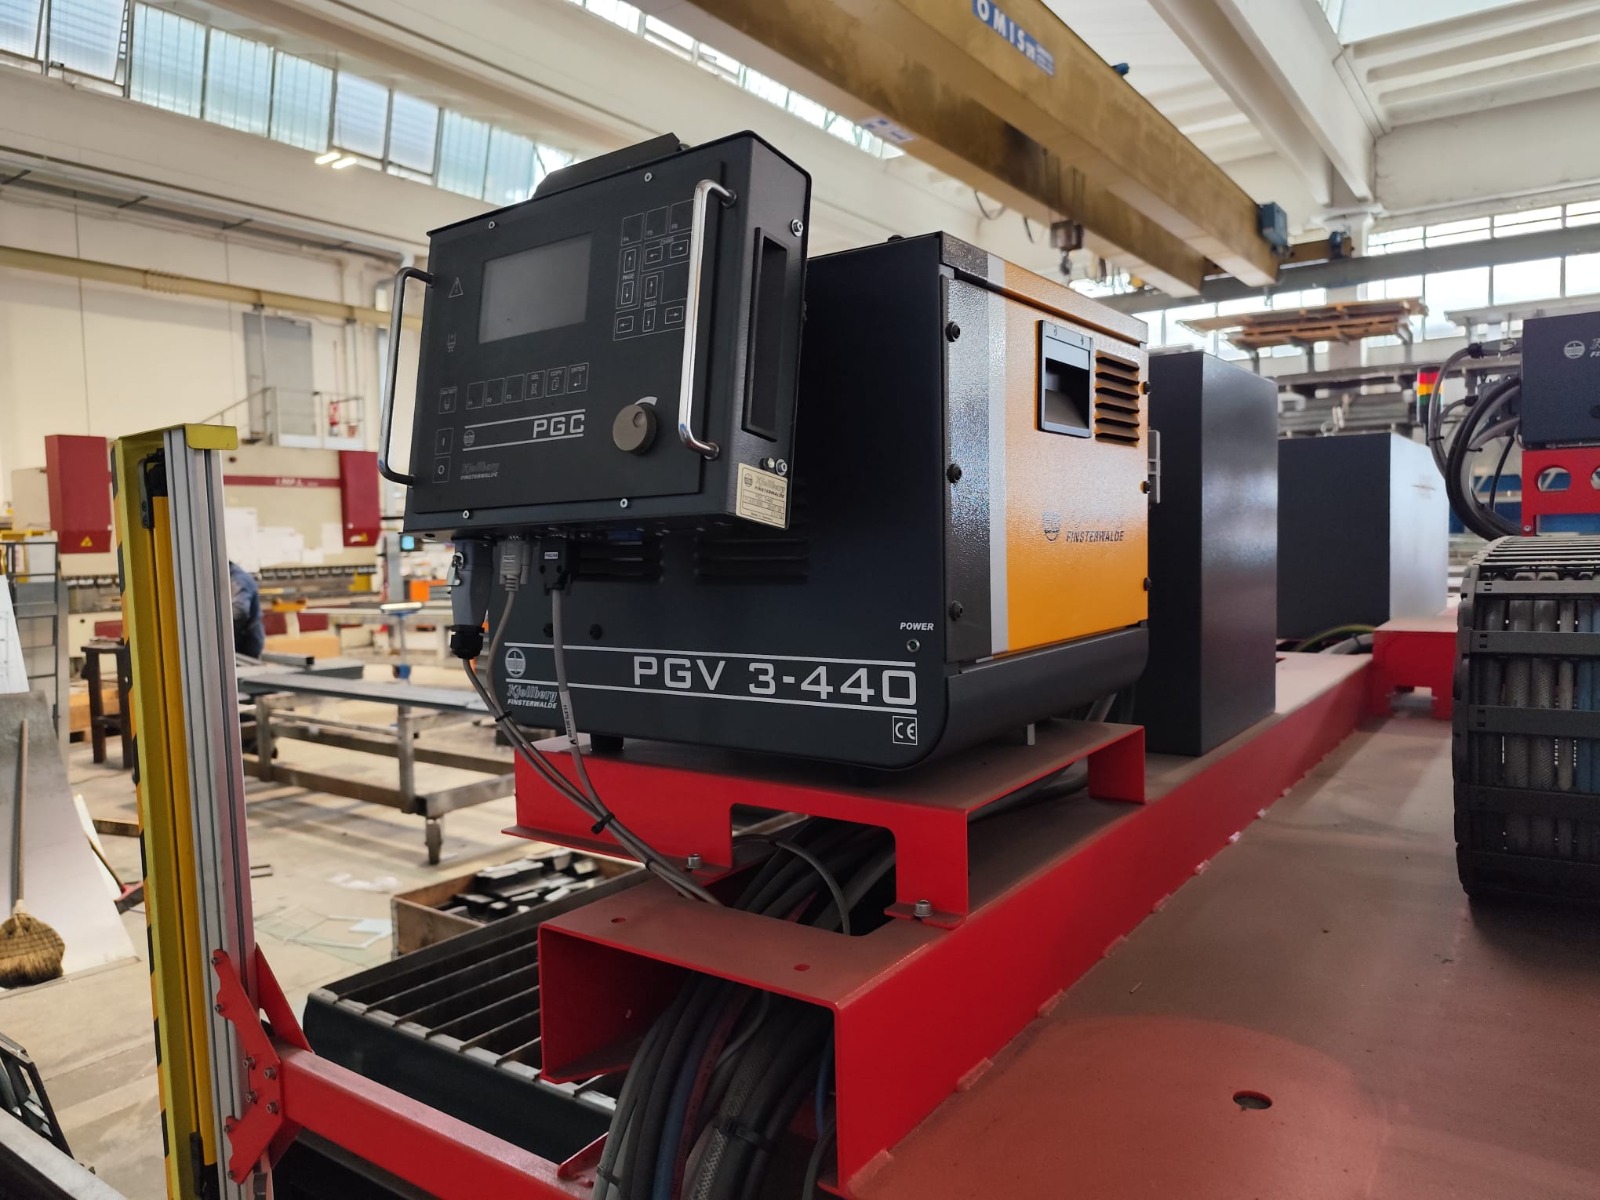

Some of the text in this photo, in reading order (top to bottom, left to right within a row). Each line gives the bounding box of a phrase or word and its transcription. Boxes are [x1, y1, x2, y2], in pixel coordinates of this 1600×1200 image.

[532, 414, 585, 438] PGC
[1066, 530, 1125, 542] FINSTERWALDE
[899, 621, 934, 631] POWER
[633, 655, 917, 706] PGV 3-440
[506, 684, 558, 703] Kjellberg
[507, 699, 558, 709] FINSTERWALDE
